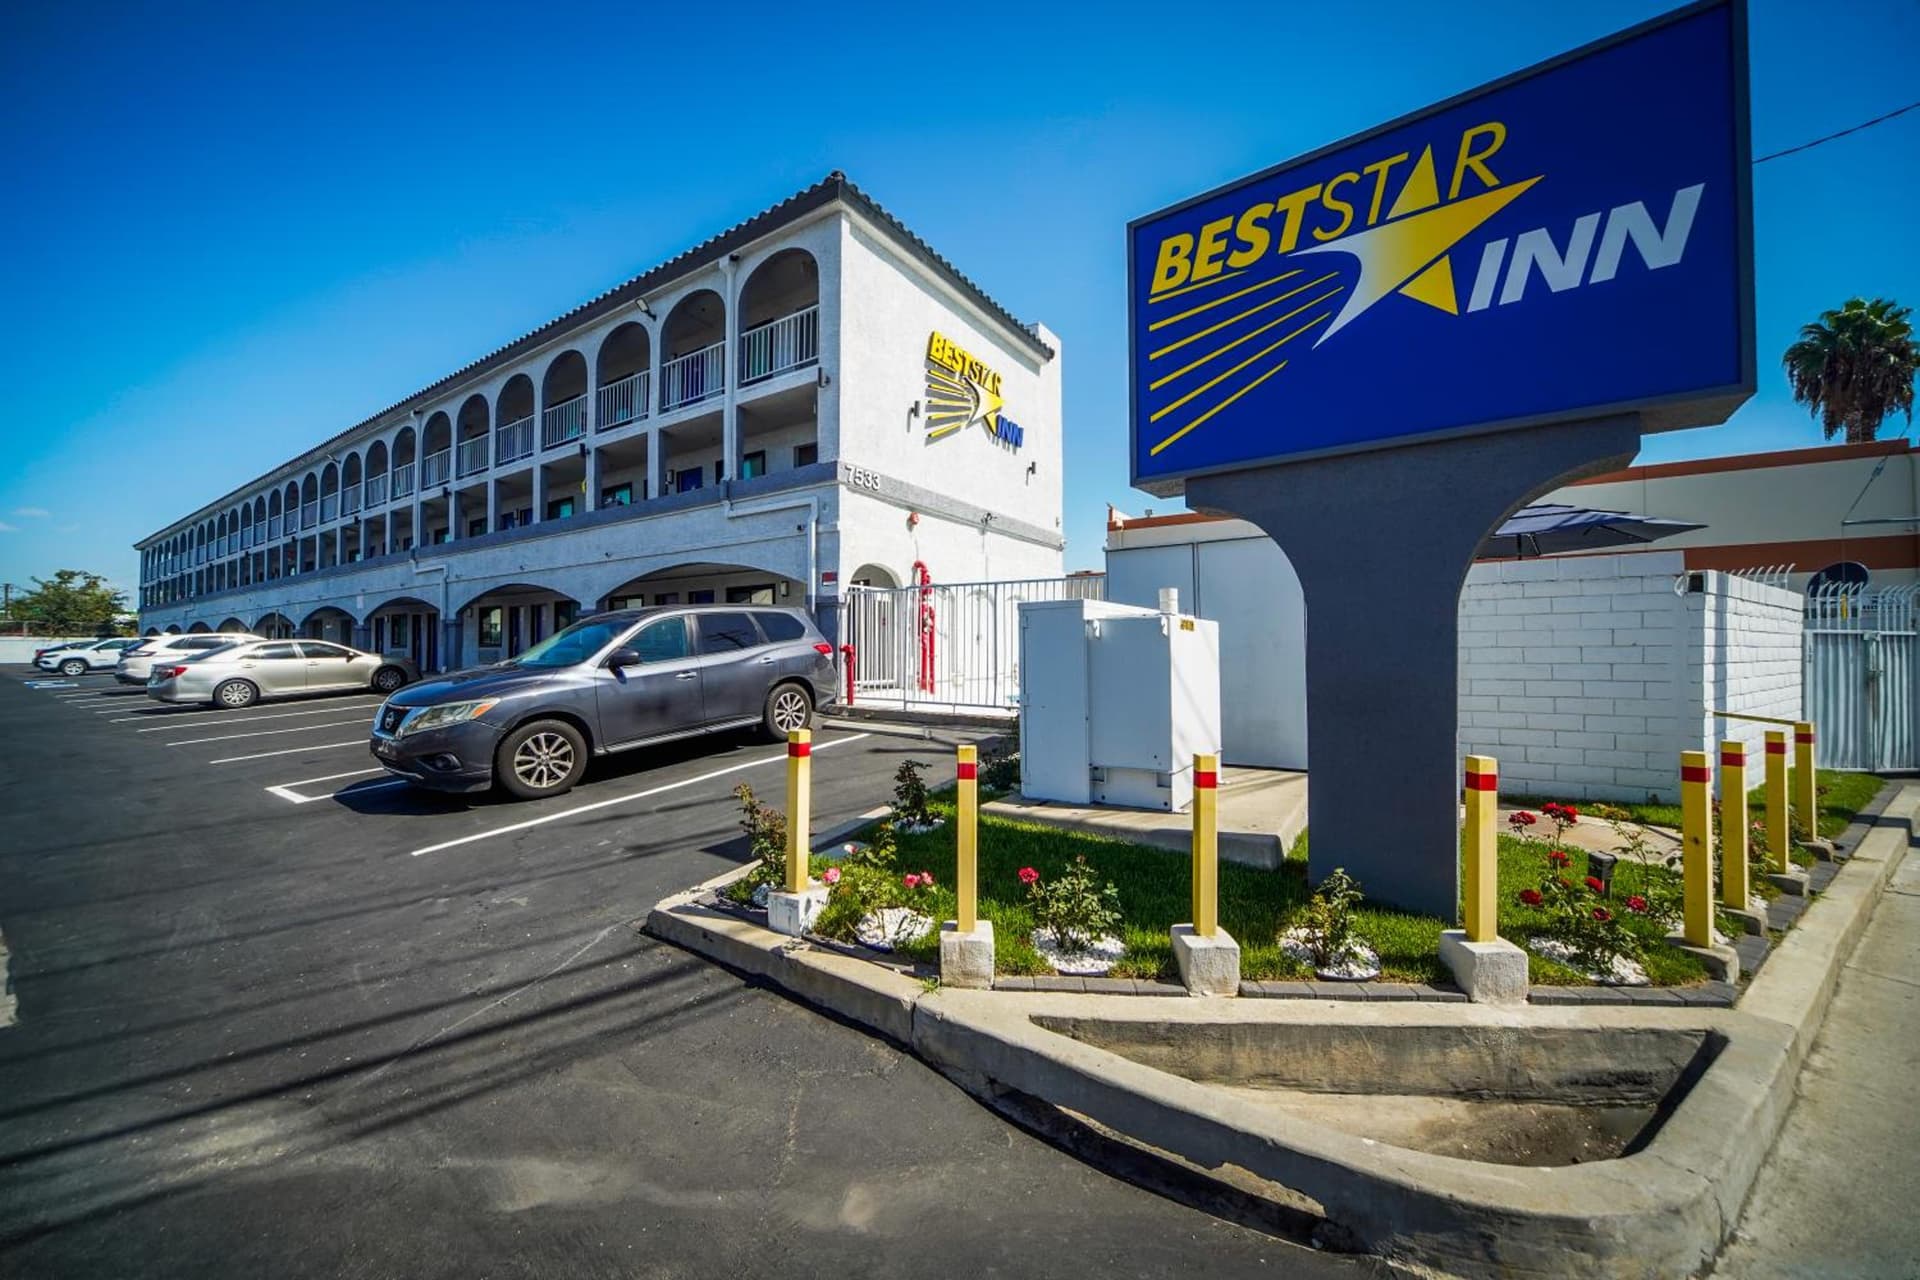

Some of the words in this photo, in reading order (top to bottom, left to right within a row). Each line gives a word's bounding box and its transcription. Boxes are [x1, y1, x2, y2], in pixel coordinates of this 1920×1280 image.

[1467, 183, 1705, 313] INN
[996, 414, 1024, 448] INN
[845, 464, 880, 491] 7533
